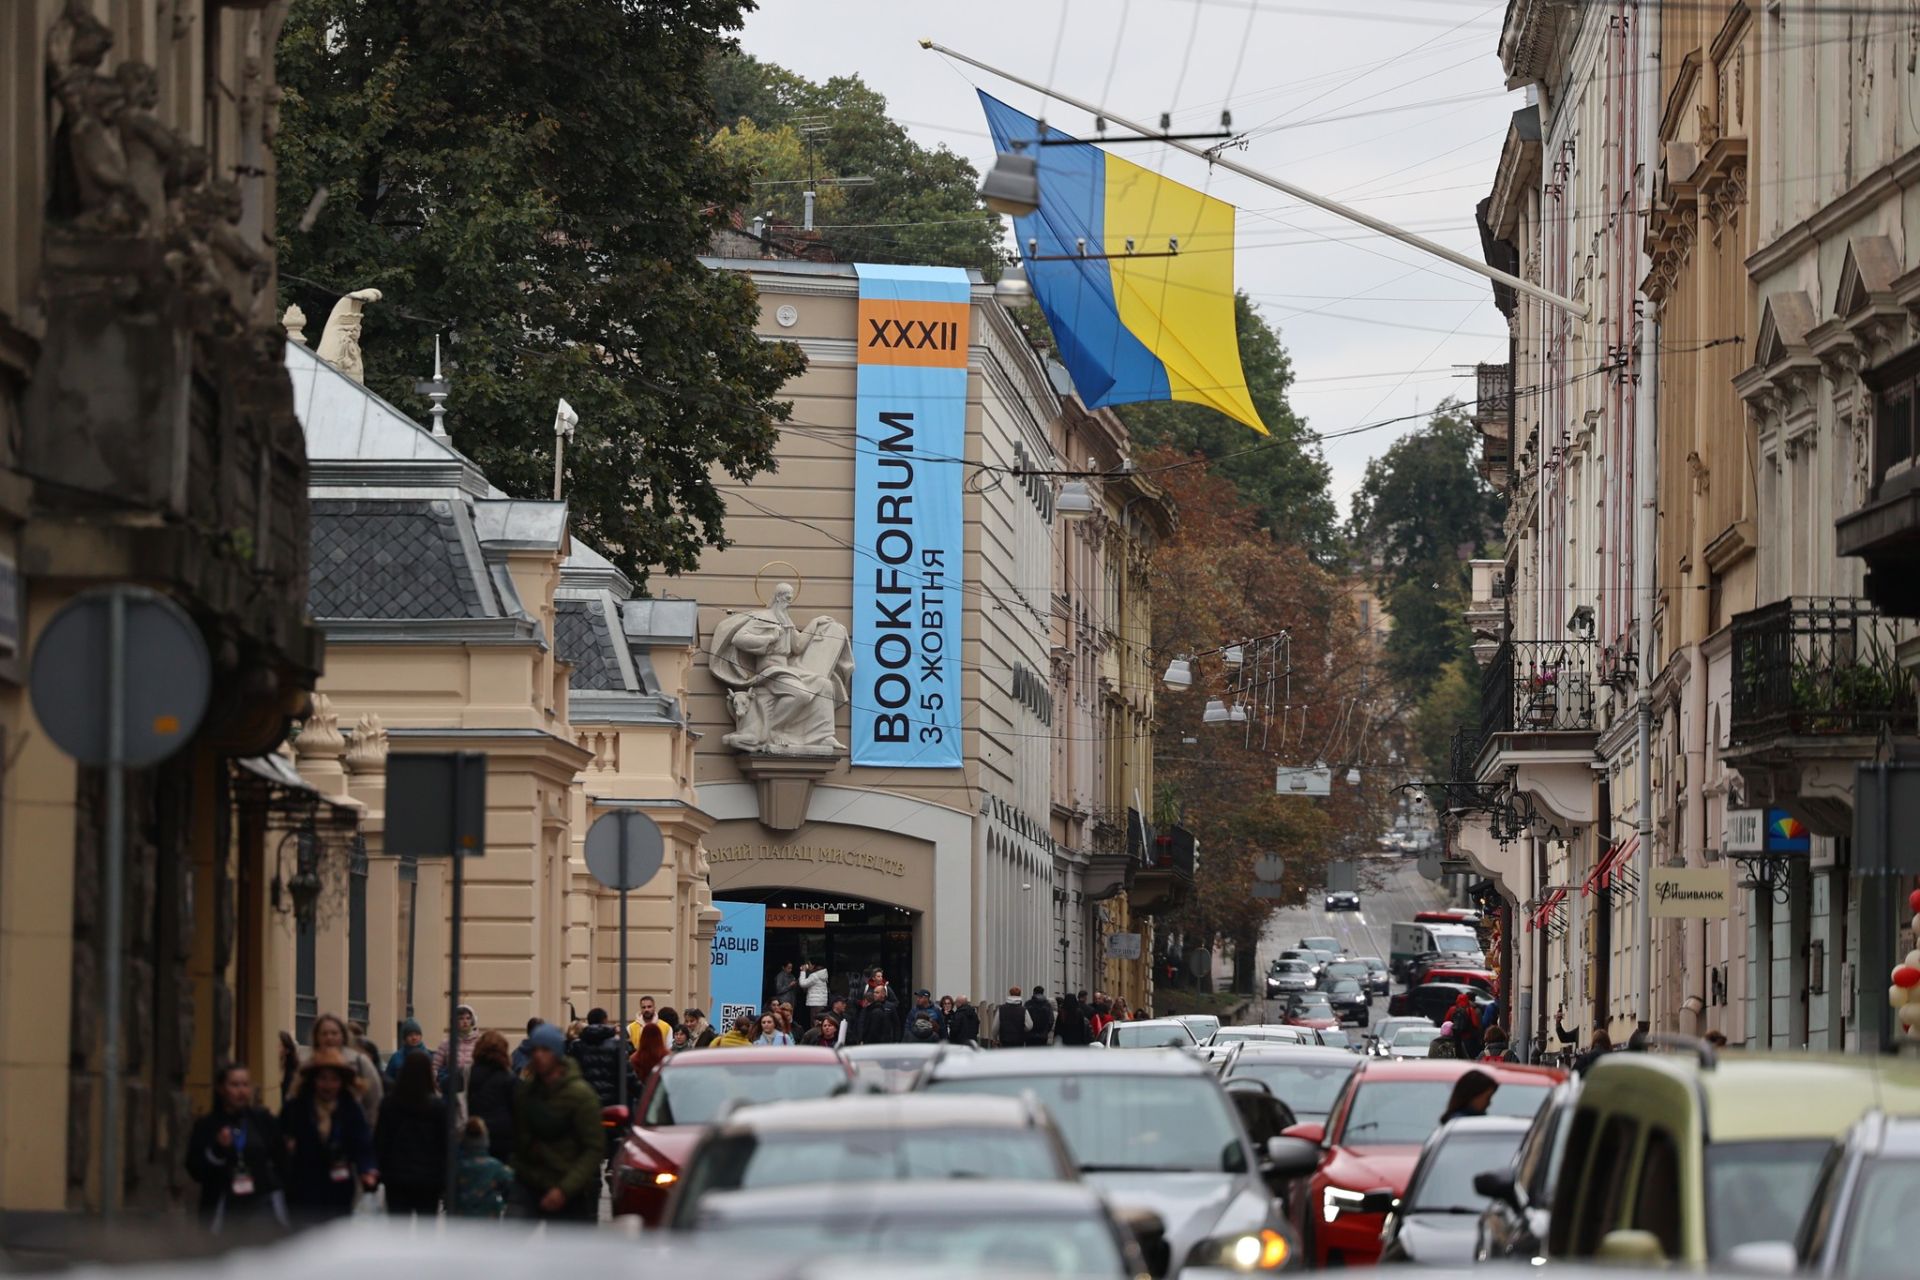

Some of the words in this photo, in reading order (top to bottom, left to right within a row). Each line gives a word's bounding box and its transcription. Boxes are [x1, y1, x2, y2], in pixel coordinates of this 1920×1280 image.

[868, 319, 957, 351] XXXII
[874, 412, 914, 742] BOOKFORUM
[920, 549, 944, 683] ЖОВТНЯ
[919, 693, 944, 744] 3-5
[758, 845, 814, 864] ПАЛАЦ
[818, 847, 905, 877] МИСТЕЦТВ
